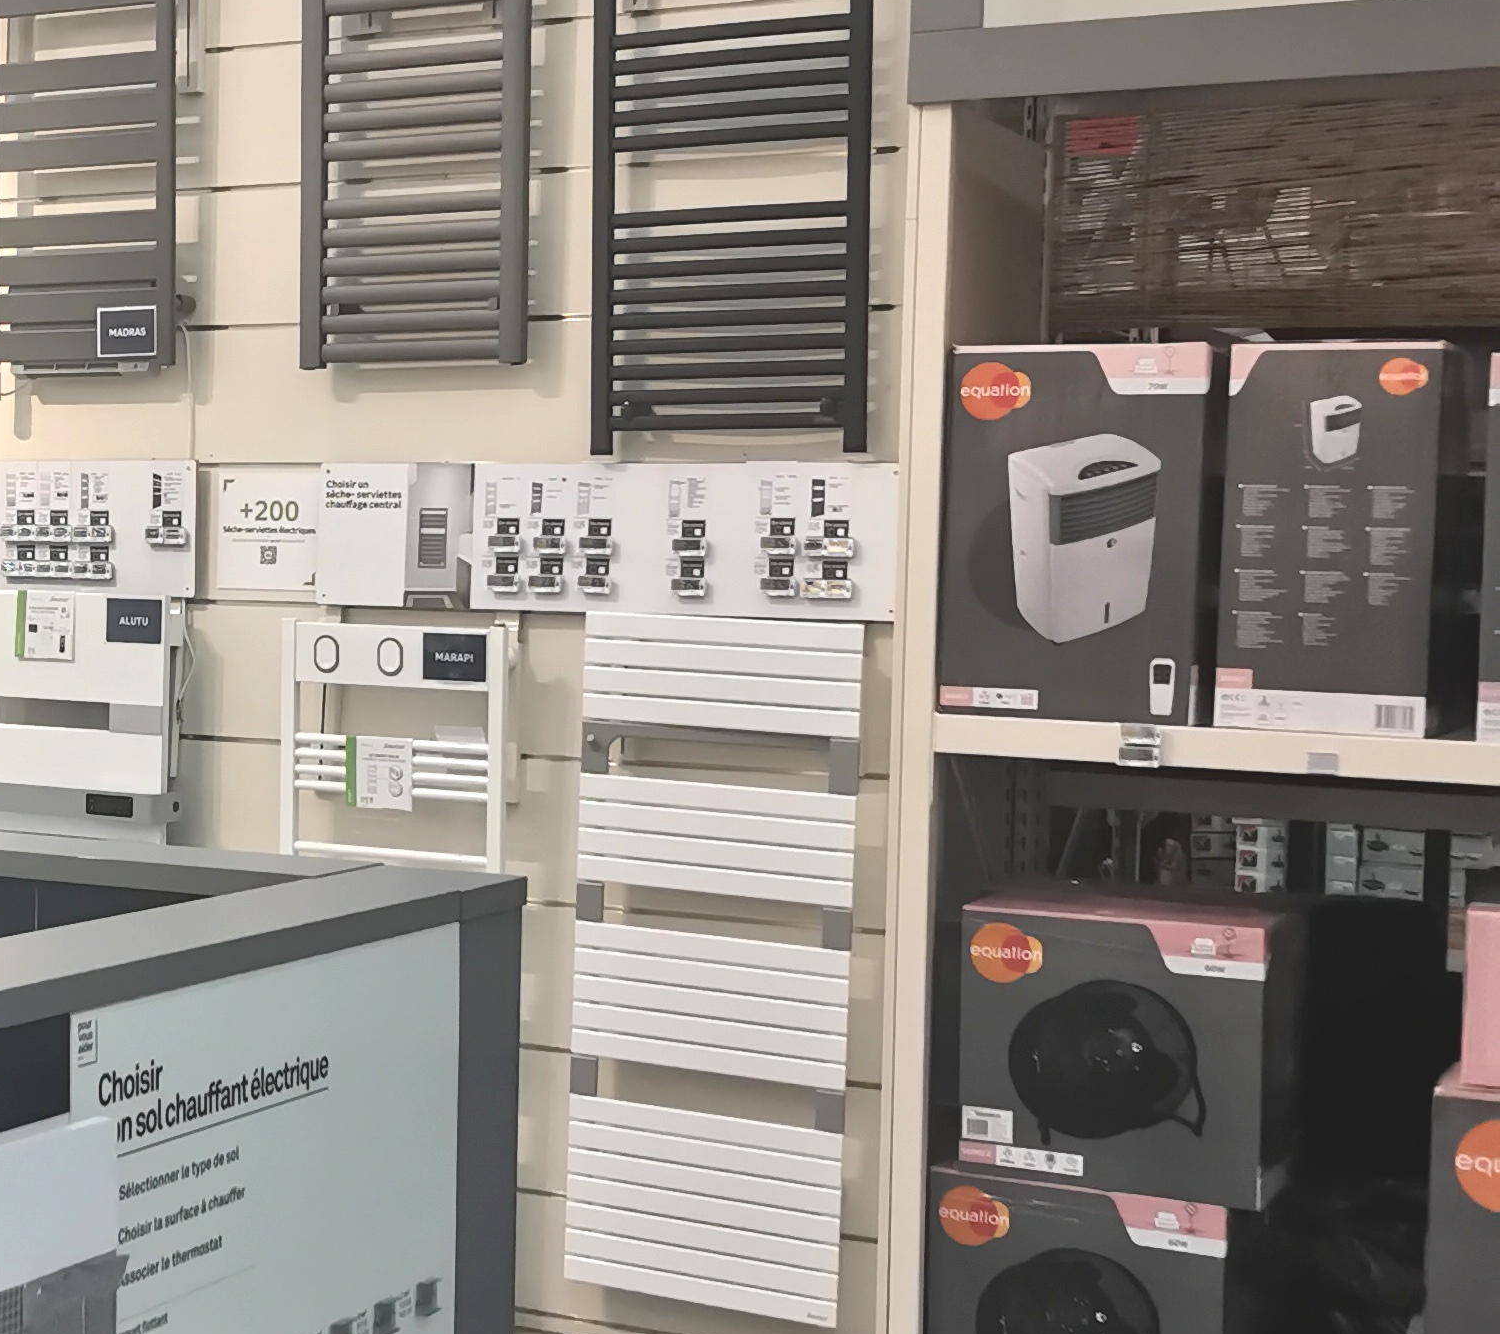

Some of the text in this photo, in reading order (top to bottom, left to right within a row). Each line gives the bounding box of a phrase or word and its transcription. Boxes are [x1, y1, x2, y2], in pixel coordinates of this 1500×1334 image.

[107, 326, 147, 338] MADRAS
[959, 383, 1032, 400] equation
[325, 479, 369, 489] Choisir un
[356, 490, 402, 499] serviettes
[240, 500, 299, 522] +200
[325, 499, 402, 511] chauffage central
[118, 617, 149, 627] ALUTU
[434, 651, 474, 664] MARAPI
[969, 943, 1043, 963] equation
[98, 1058, 164, 1107] Choisir
[136, 1097, 163, 1139] sol
[164, 1073, 249, 1128] chauffant
[250, 1055, 330, 1102] électrique
[118, 1145, 240, 1201] Sélectionner le type de sol
[118, 1219, 153, 1245] Choisir
[164, 1204, 200, 1229] surface
[208, 1186, 246, 1212] chauffer
[937, 1204, 1010, 1224] equation
[120, 1261, 160, 1287] ssocier
[171, 1234, 223, 1268] thermostat
